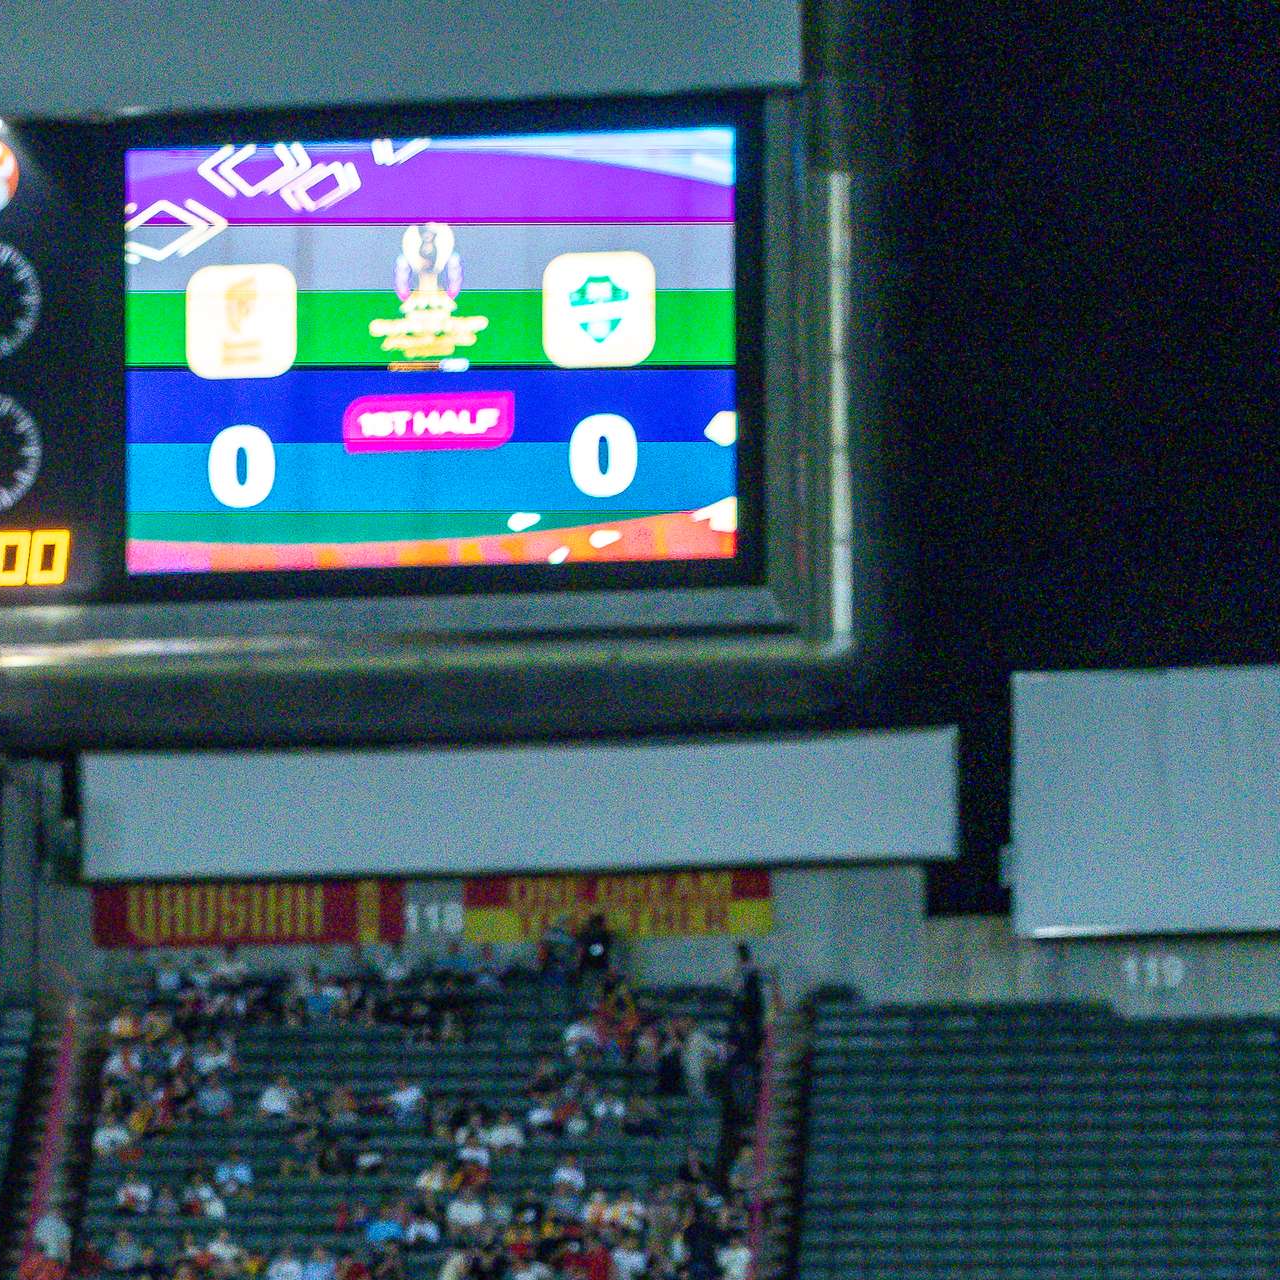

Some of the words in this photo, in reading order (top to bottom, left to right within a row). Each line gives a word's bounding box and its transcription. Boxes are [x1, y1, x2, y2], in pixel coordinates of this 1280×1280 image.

[357, 409, 411, 437] 1ST
[414, 407, 500, 435] HALF
[568, 412, 639, 498] 0
[208, 424, 276, 509] 0
